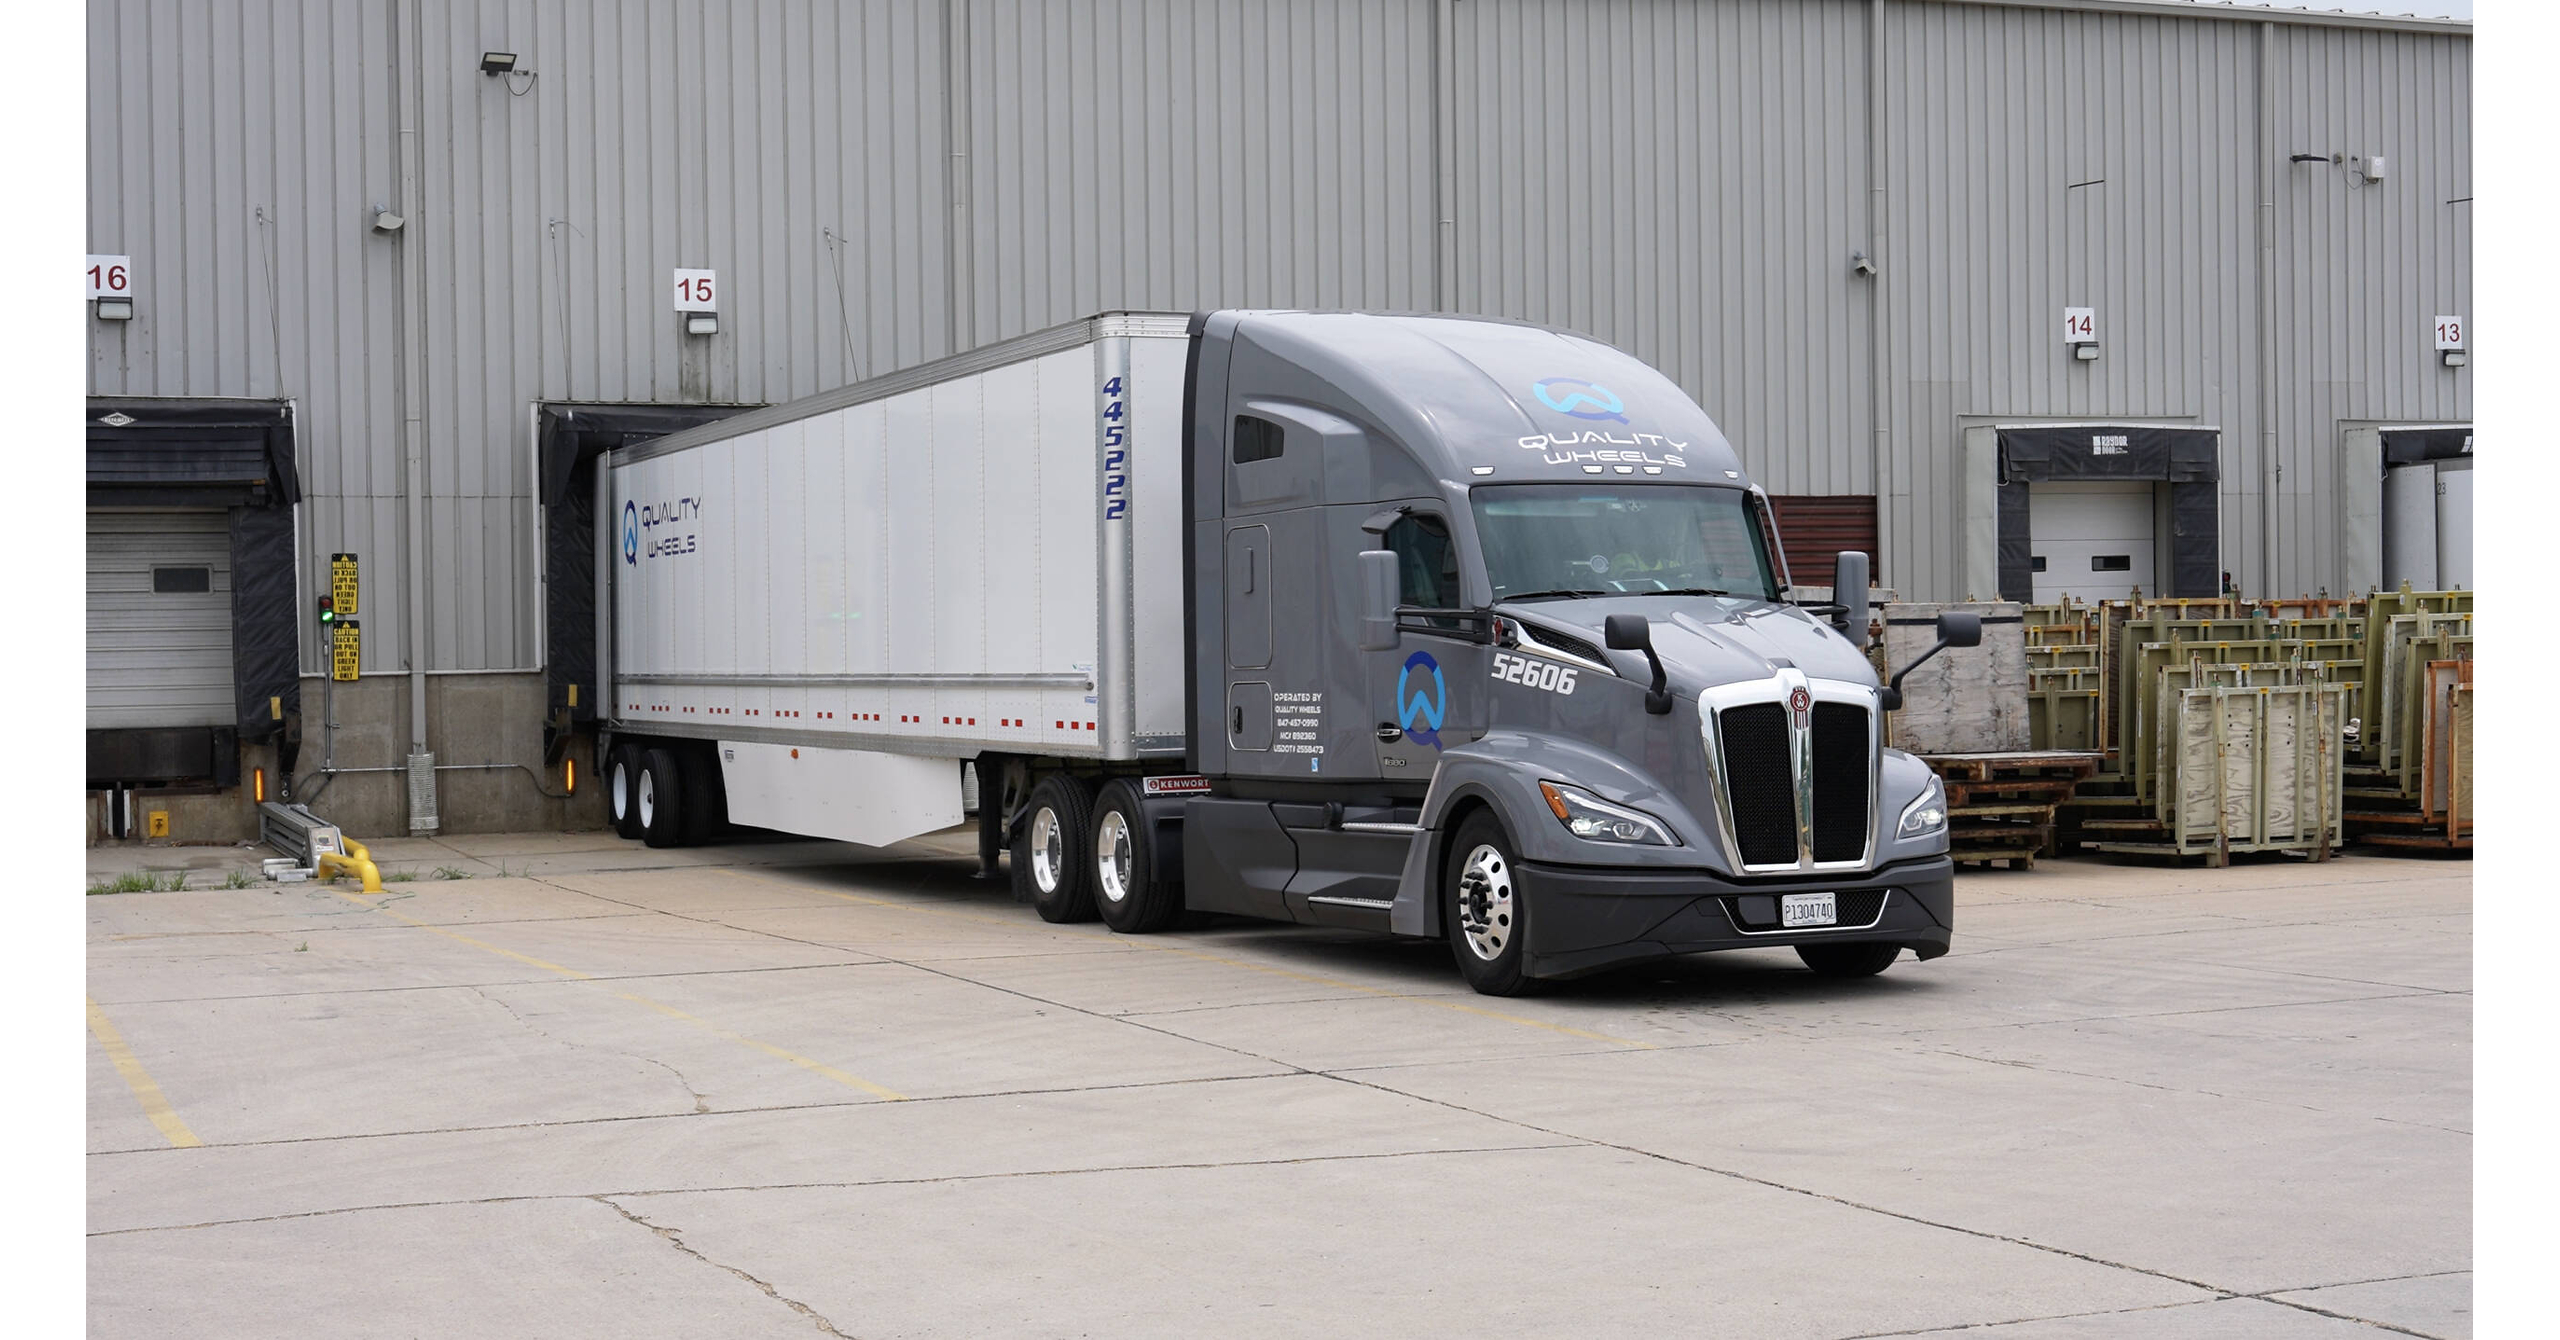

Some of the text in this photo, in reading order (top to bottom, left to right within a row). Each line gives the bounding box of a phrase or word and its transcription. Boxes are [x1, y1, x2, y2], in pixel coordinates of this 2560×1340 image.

[87, 264, 127, 290] 16
[677, 278, 712, 302] 15
[2067, 315, 2092, 335] 14
[2437, 323, 2460, 342] 13
[1102, 377, 1126, 520] 445222
[1518, 431, 1688, 451] QUALITY
[1543, 450, 1687, 468] WHEELS
[642, 496, 701, 532] QUALITY
[647, 534, 696, 558] WHEELS
[1490, 652, 1578, 696] 52606
[1273, 693, 1322, 702] OPERATED BY
[1275, 705, 1321, 713] QUALITY WHEELS
[1160, 779, 1209, 788] KENWORT
[1785, 903, 1833, 920] P1304740
